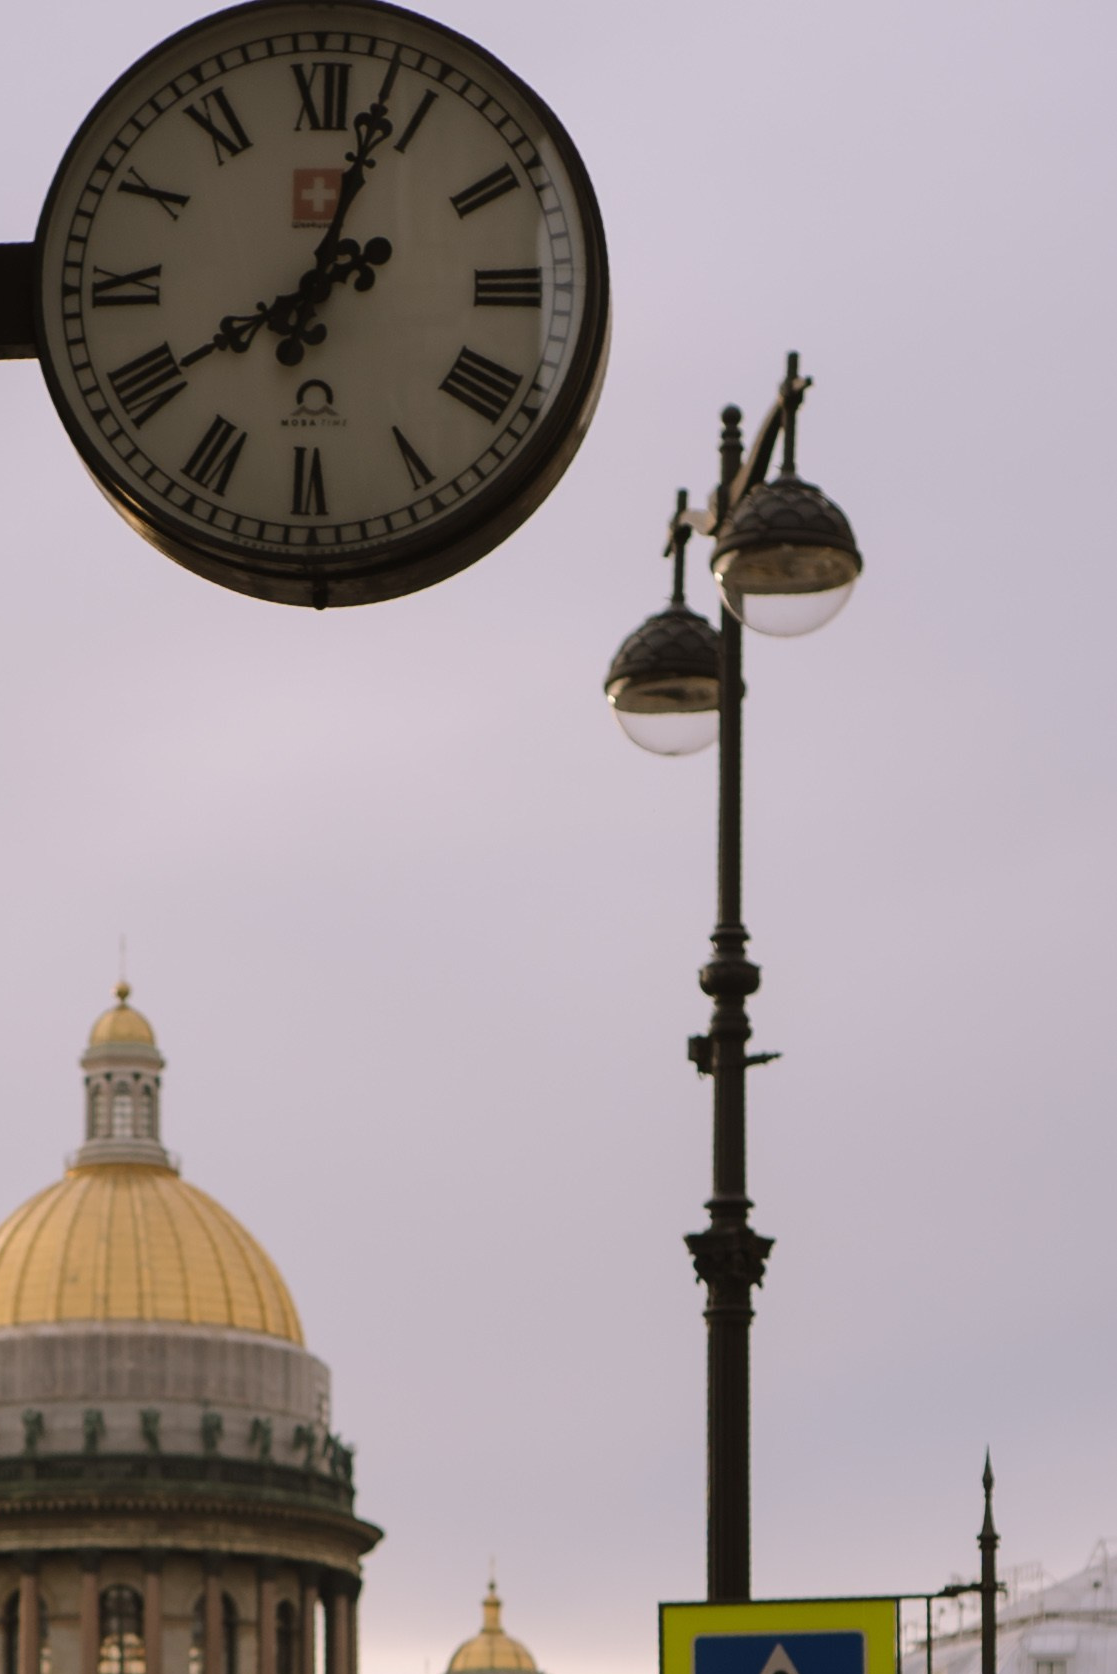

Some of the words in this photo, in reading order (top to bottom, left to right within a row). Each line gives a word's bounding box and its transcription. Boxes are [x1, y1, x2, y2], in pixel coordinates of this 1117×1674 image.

[183, 86, 253, 166] XI
[291, 62, 352, 132] XII
[394, 89, 438, 153] I
[118, 167, 190, 220] X
[450, 163, 520, 219] II
[92, 264, 163, 309] IX
[474, 267, 542, 308] III
[106, 342, 189, 429] VIII
[180, 414, 248, 497] VII
[290, 446, 329, 515] VI
[392, 425, 436, 491] V
